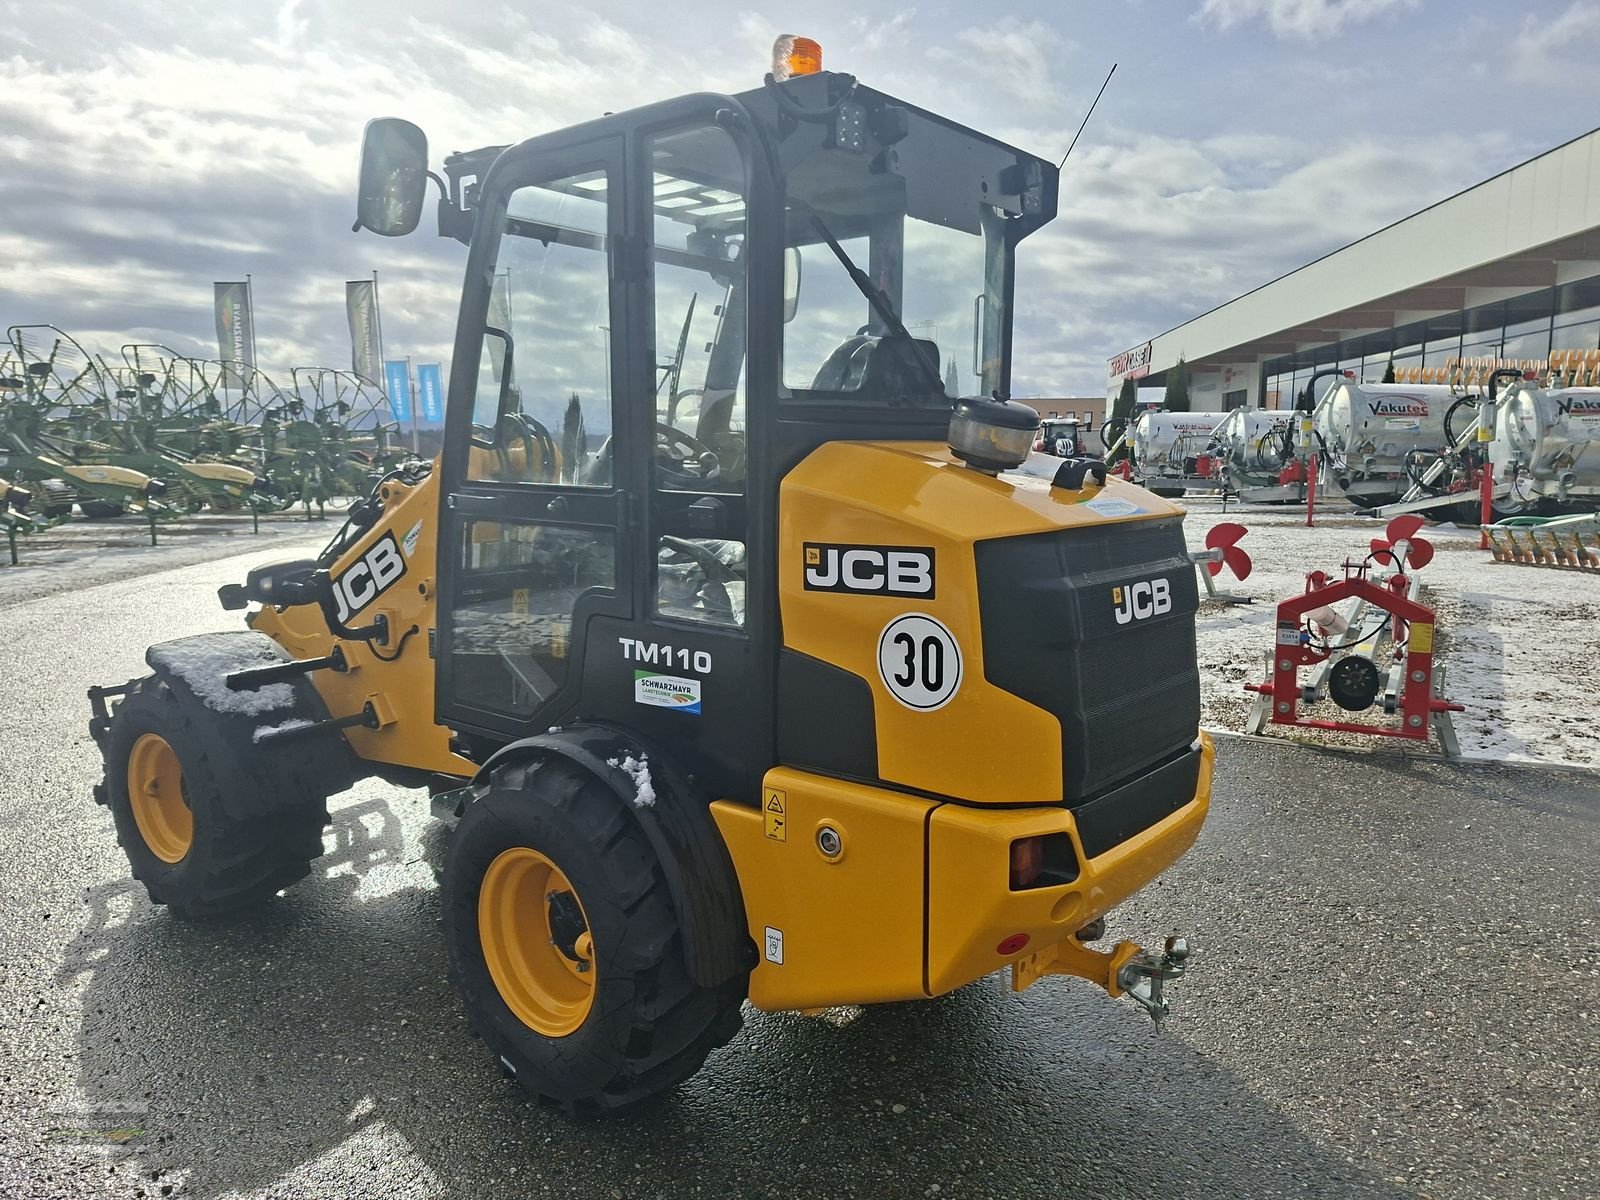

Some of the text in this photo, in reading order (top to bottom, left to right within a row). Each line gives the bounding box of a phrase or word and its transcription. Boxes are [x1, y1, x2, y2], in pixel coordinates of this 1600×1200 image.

[1368, 400, 1429, 416] Vakutec
[333, 537, 404, 623] JCB
[806, 548, 932, 593] JCB
[1113, 578, 1173, 625] JCB
[618, 637, 712, 674] TM110
[893, 632, 945, 692] 30
[641, 679, 692, 694] SCHWARZMAYR
